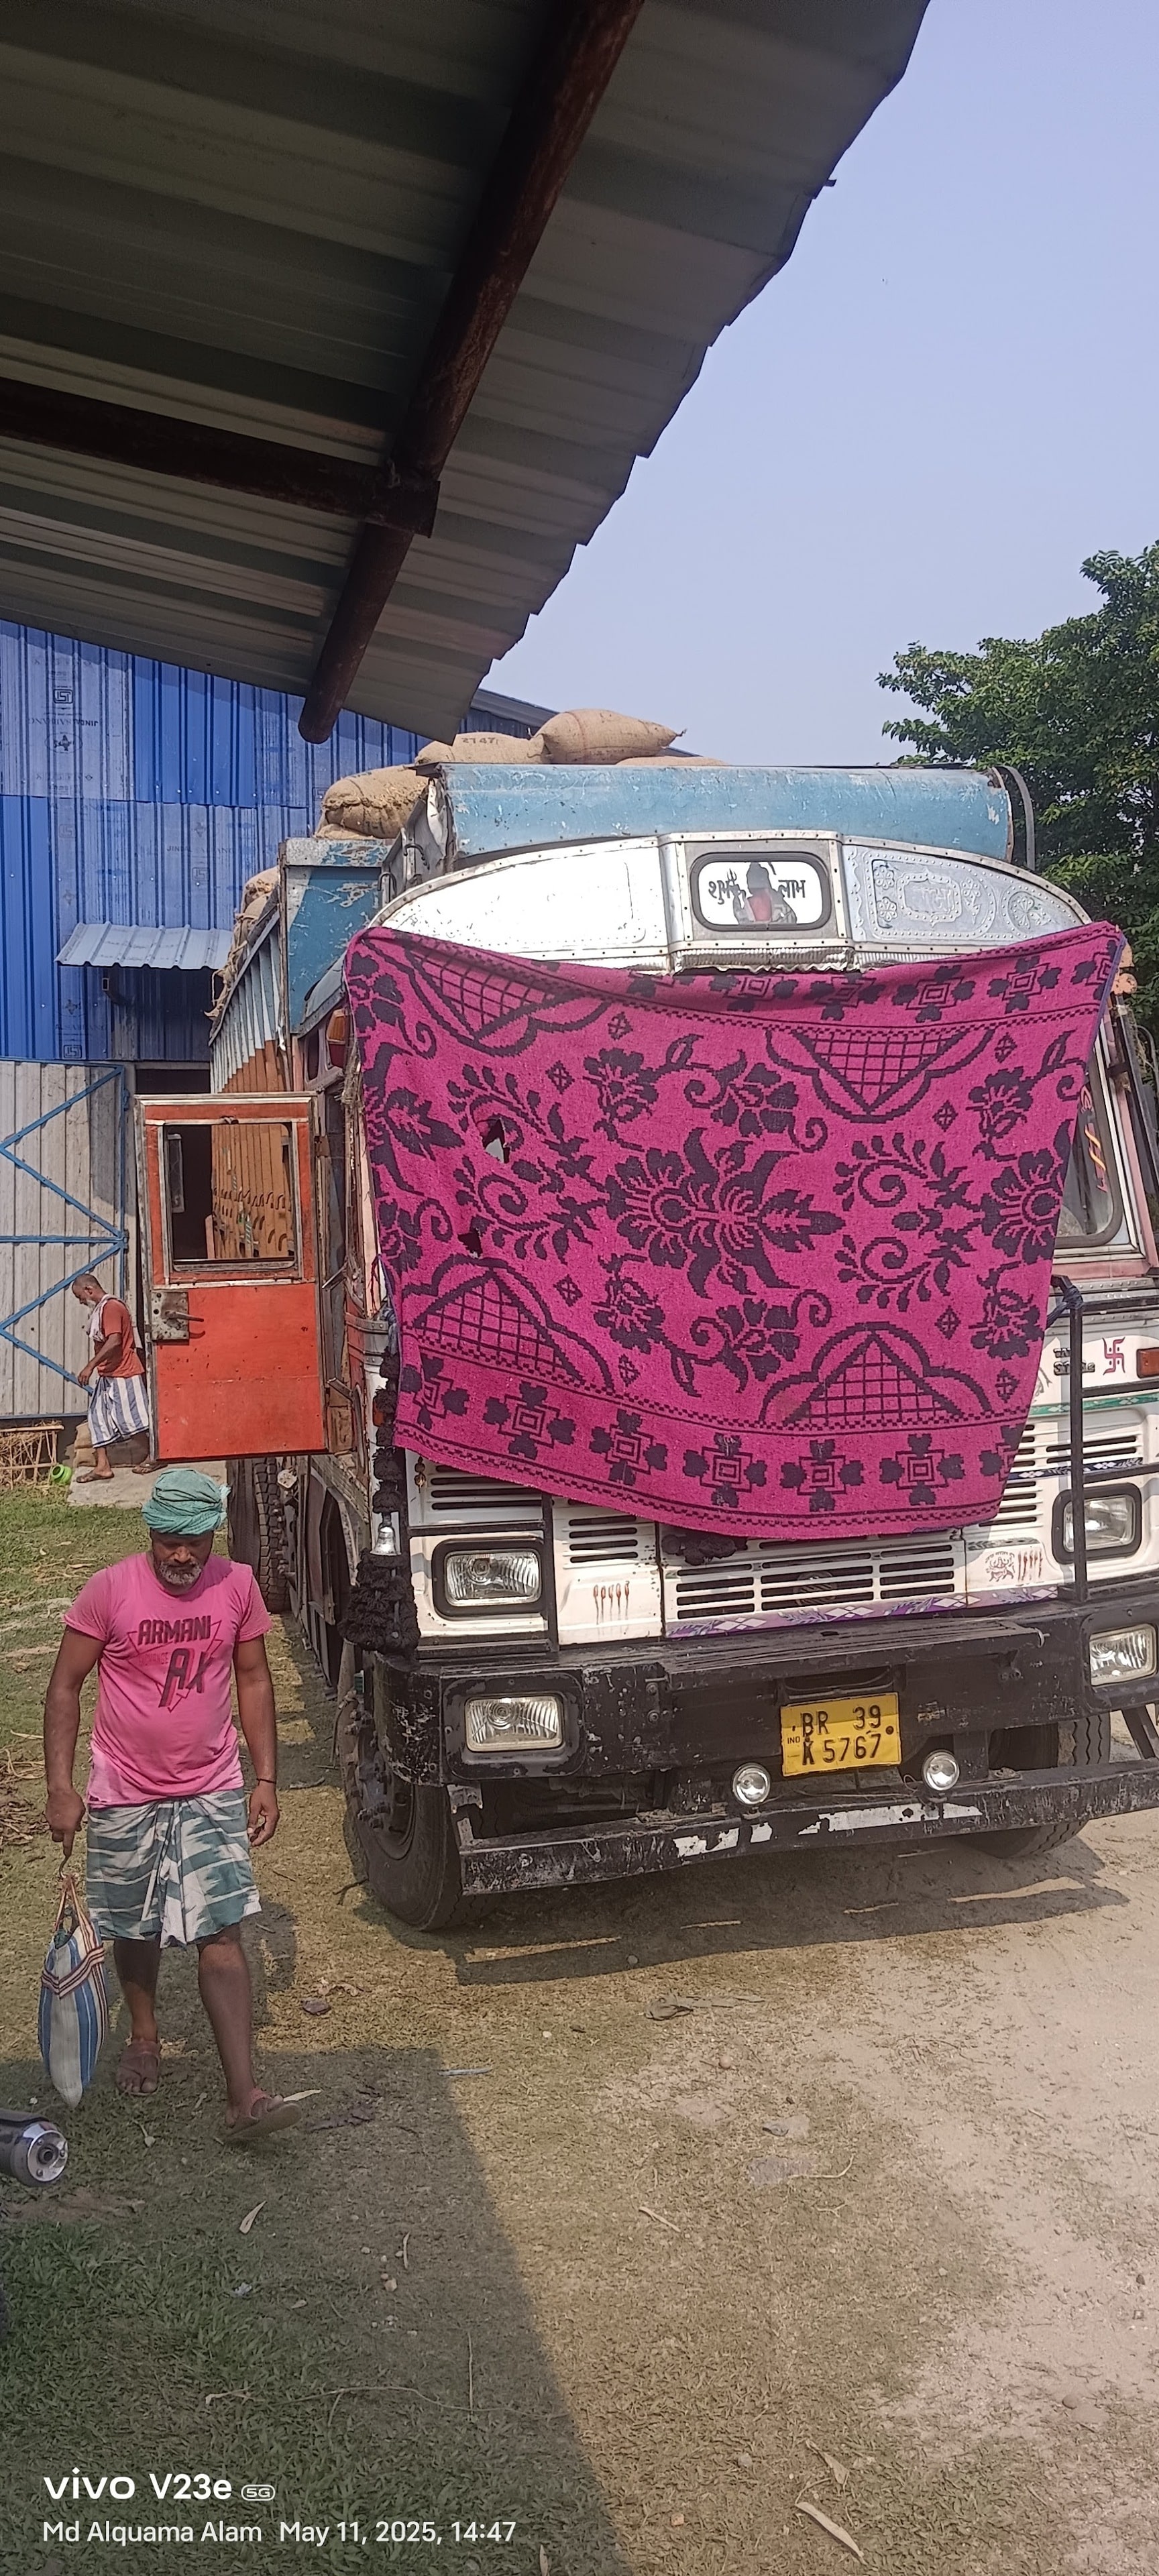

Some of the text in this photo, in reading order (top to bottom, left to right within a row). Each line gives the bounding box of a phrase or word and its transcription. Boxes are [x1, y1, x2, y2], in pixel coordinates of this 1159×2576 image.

[137, 1615, 211, 1646] ARMANI
[802, 1704, 881, 1736] BR 39
